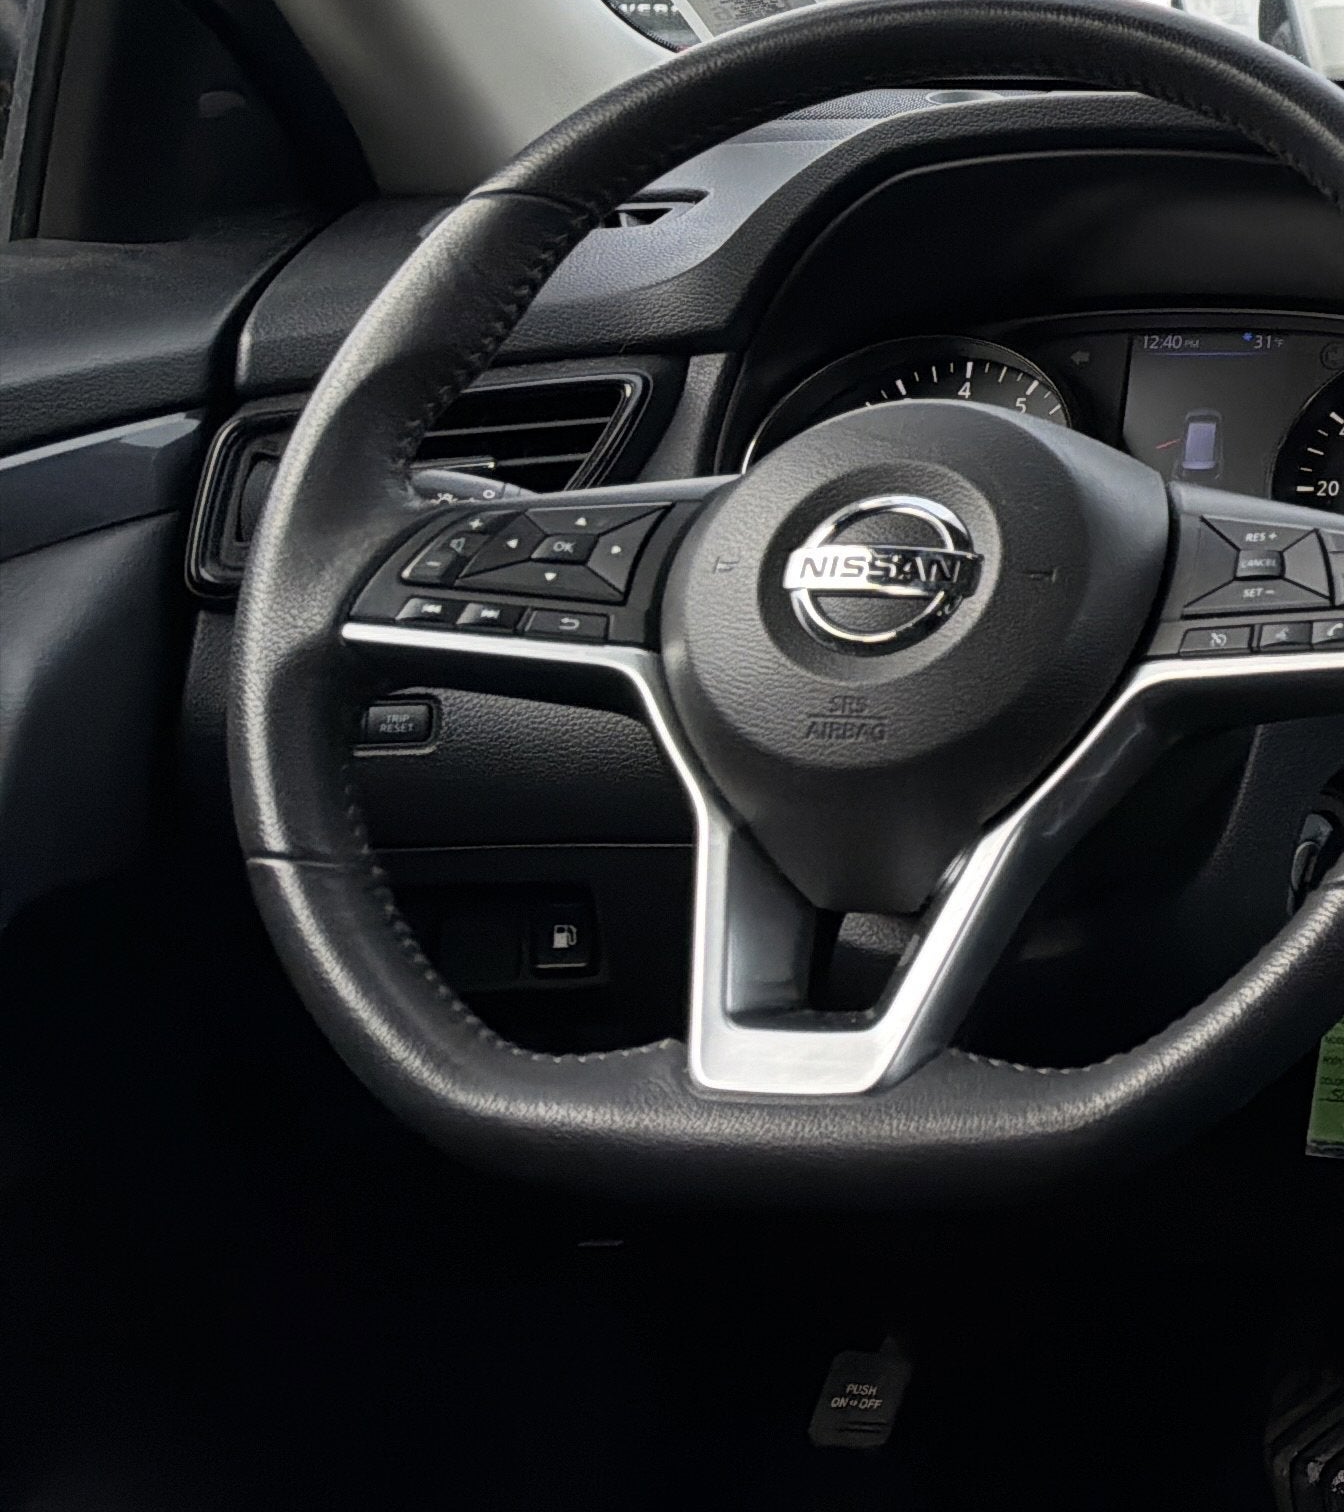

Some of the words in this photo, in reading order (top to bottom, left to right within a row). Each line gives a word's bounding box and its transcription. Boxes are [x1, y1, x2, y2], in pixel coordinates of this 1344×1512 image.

[1143, 335, 1183, 349] 12:40
[957, 382, 972, 399] 4
[1015, 397, 1028, 416] 5
[1316, 481, 1340, 496] 20
[1245, 531, 1266, 541] RES
[552, 541, 574, 553] OK
[799, 554, 962, 584] NISSAN
[1240, 558, 1277, 569] CANCEL
[1242, 587, 1263, 598] SET
[828, 695, 868, 714] SRS
[385, 714, 410, 723] TRIP
[379, 723, 415, 733] RESET
[804, 720, 888, 740] AIRBAG
[845, 1383, 878, 1396] PUSH
[830, 1396, 849, 1409] ON
[858, 1398, 883, 1410] OFF
